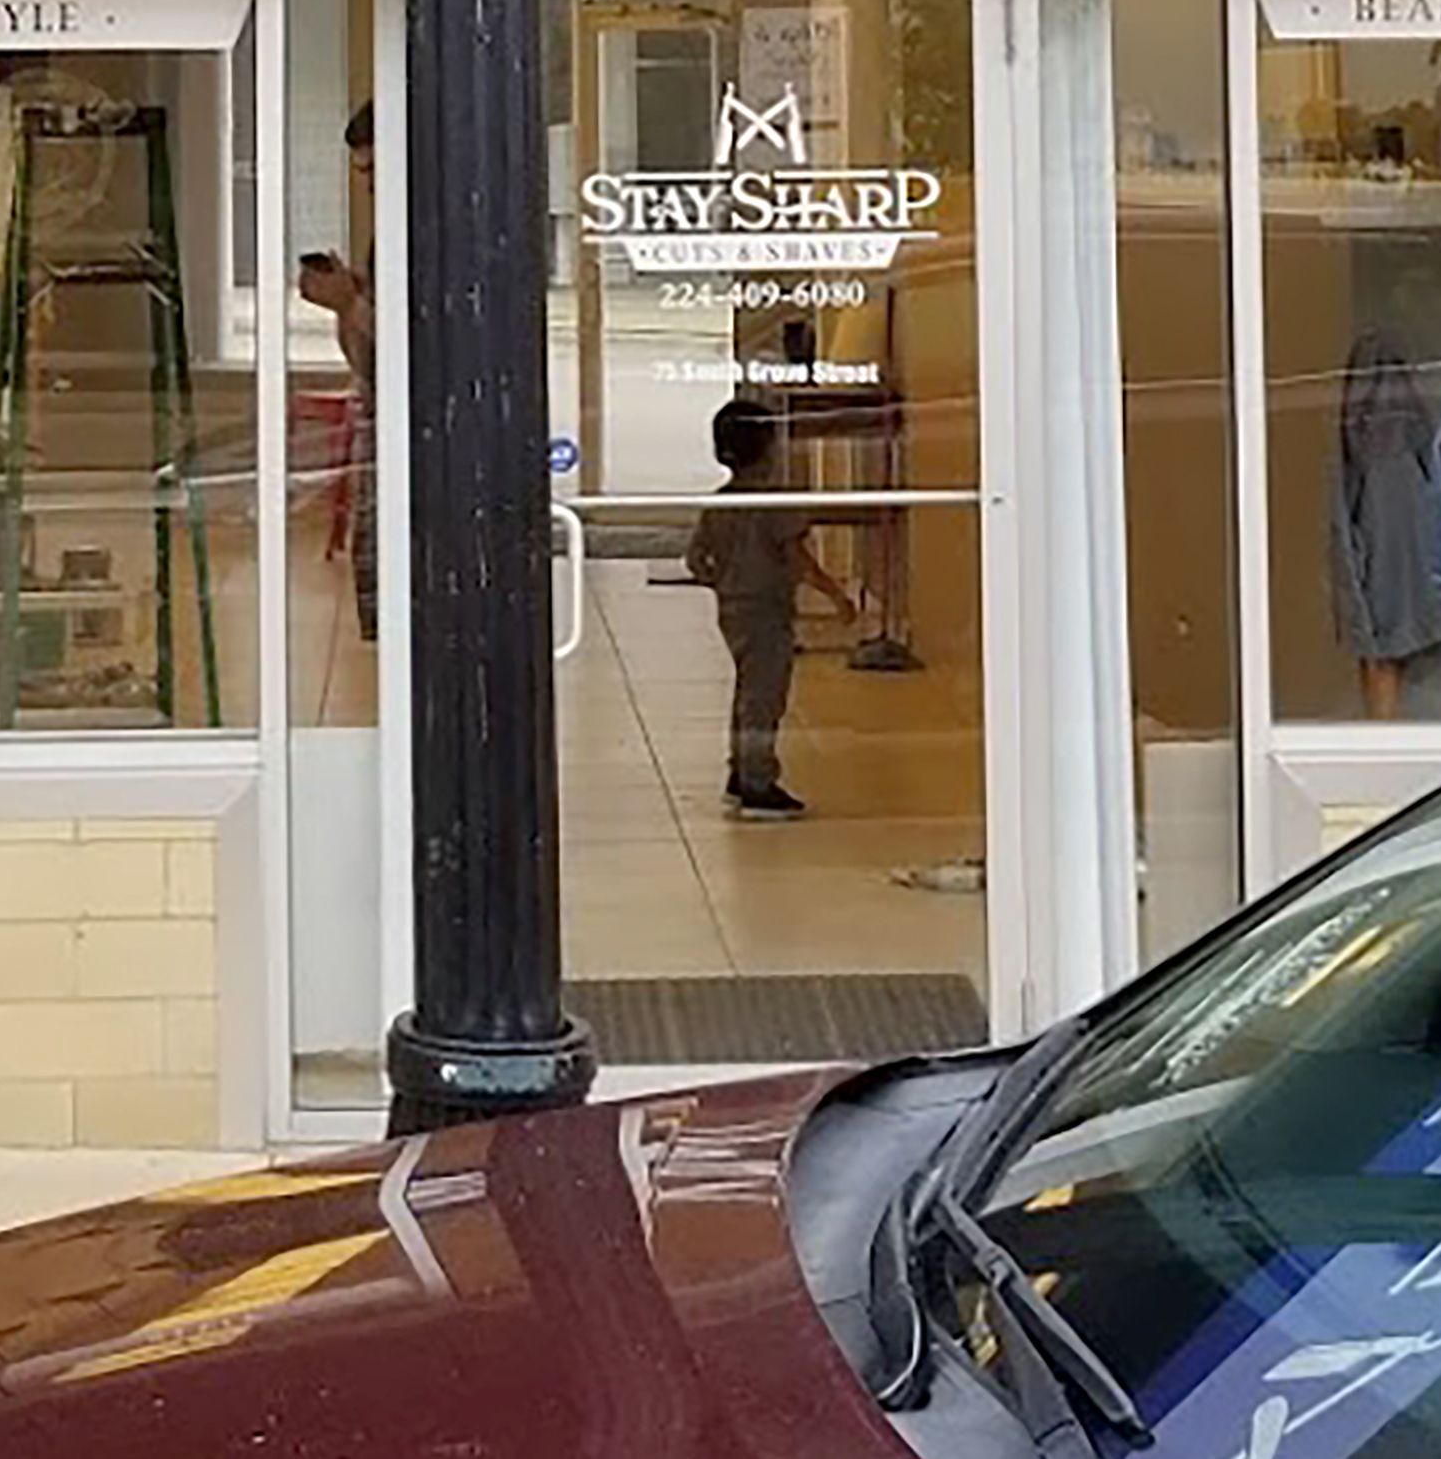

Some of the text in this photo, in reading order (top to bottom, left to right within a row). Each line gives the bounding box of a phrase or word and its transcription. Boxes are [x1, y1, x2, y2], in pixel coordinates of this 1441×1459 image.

[581, 170, 941, 231] STAY SHARP
[654, 240, 871, 264] CUTS & SHAVES
[659, 279, 867, 309] 224-409-6080
[812, 360, 880, 384] Street
